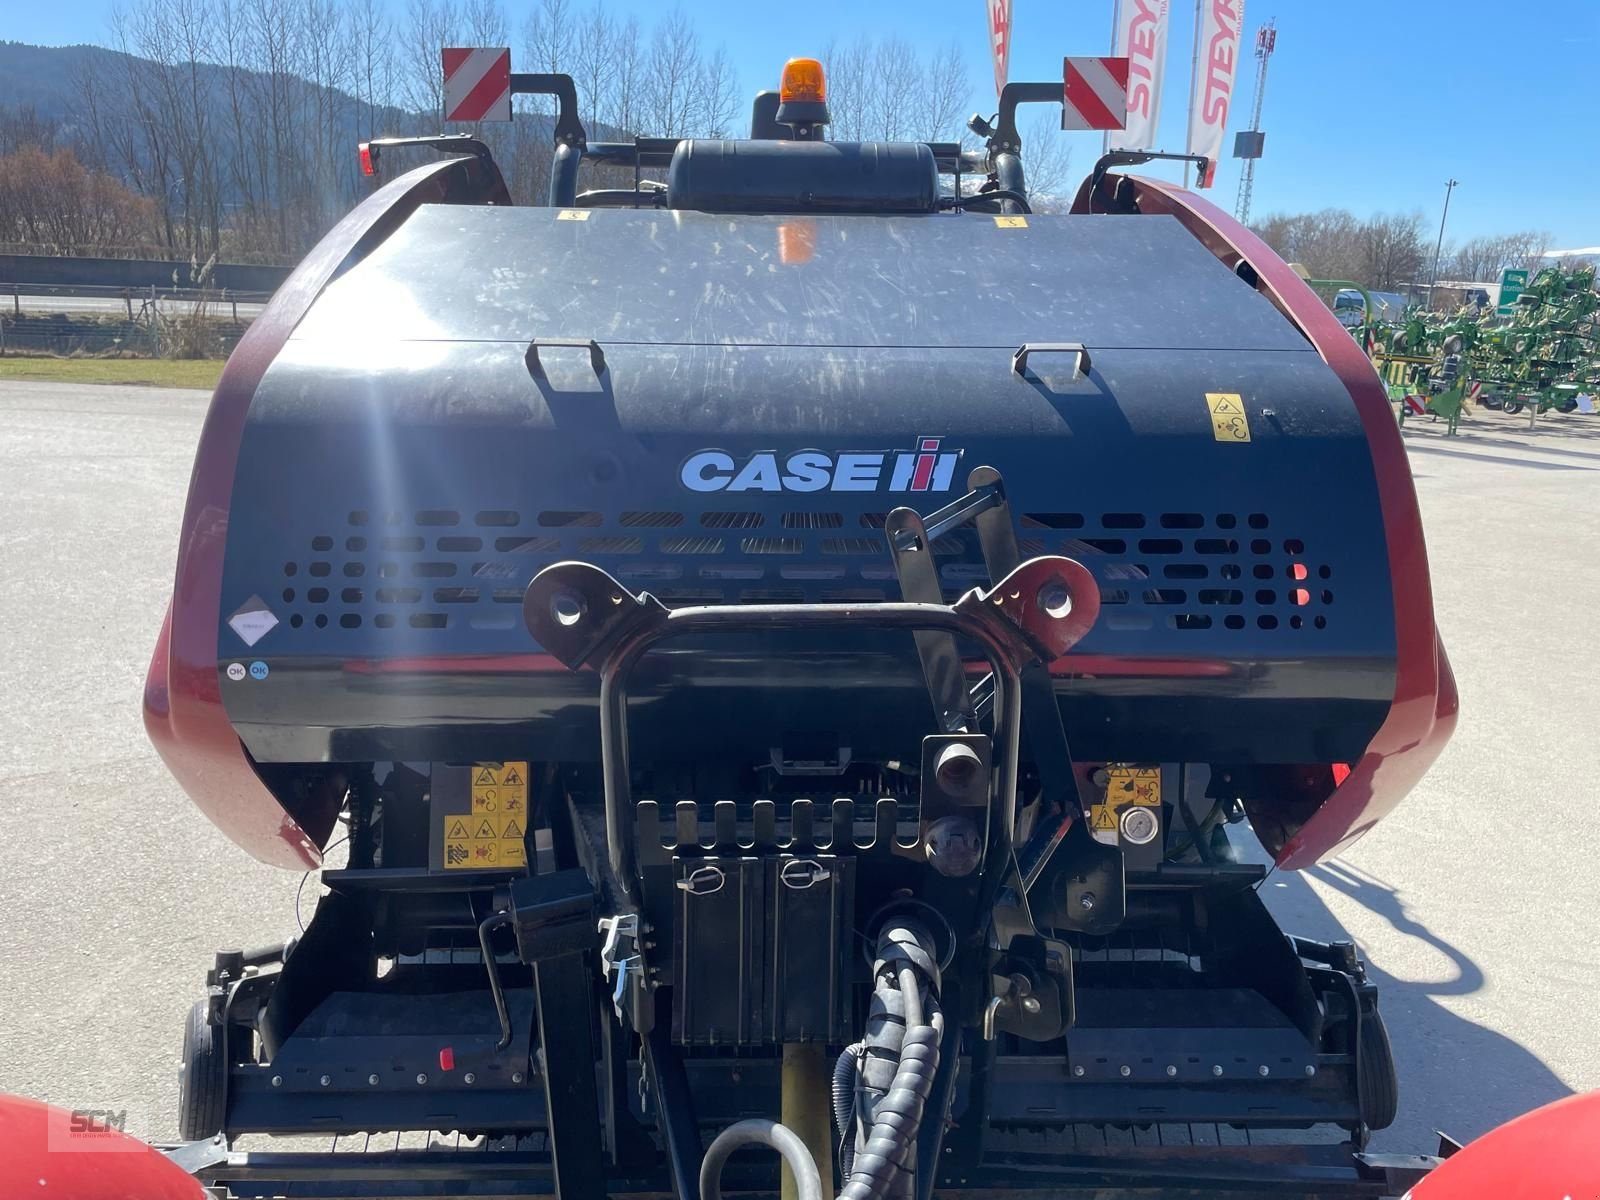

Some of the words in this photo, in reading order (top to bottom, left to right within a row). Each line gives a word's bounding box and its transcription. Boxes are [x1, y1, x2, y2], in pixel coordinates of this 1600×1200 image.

[1126, 0, 1158, 120] STEY
[680, 451, 884, 493] CASE
[229, 667, 244, 676] OK
[251, 665, 267, 675] OK
